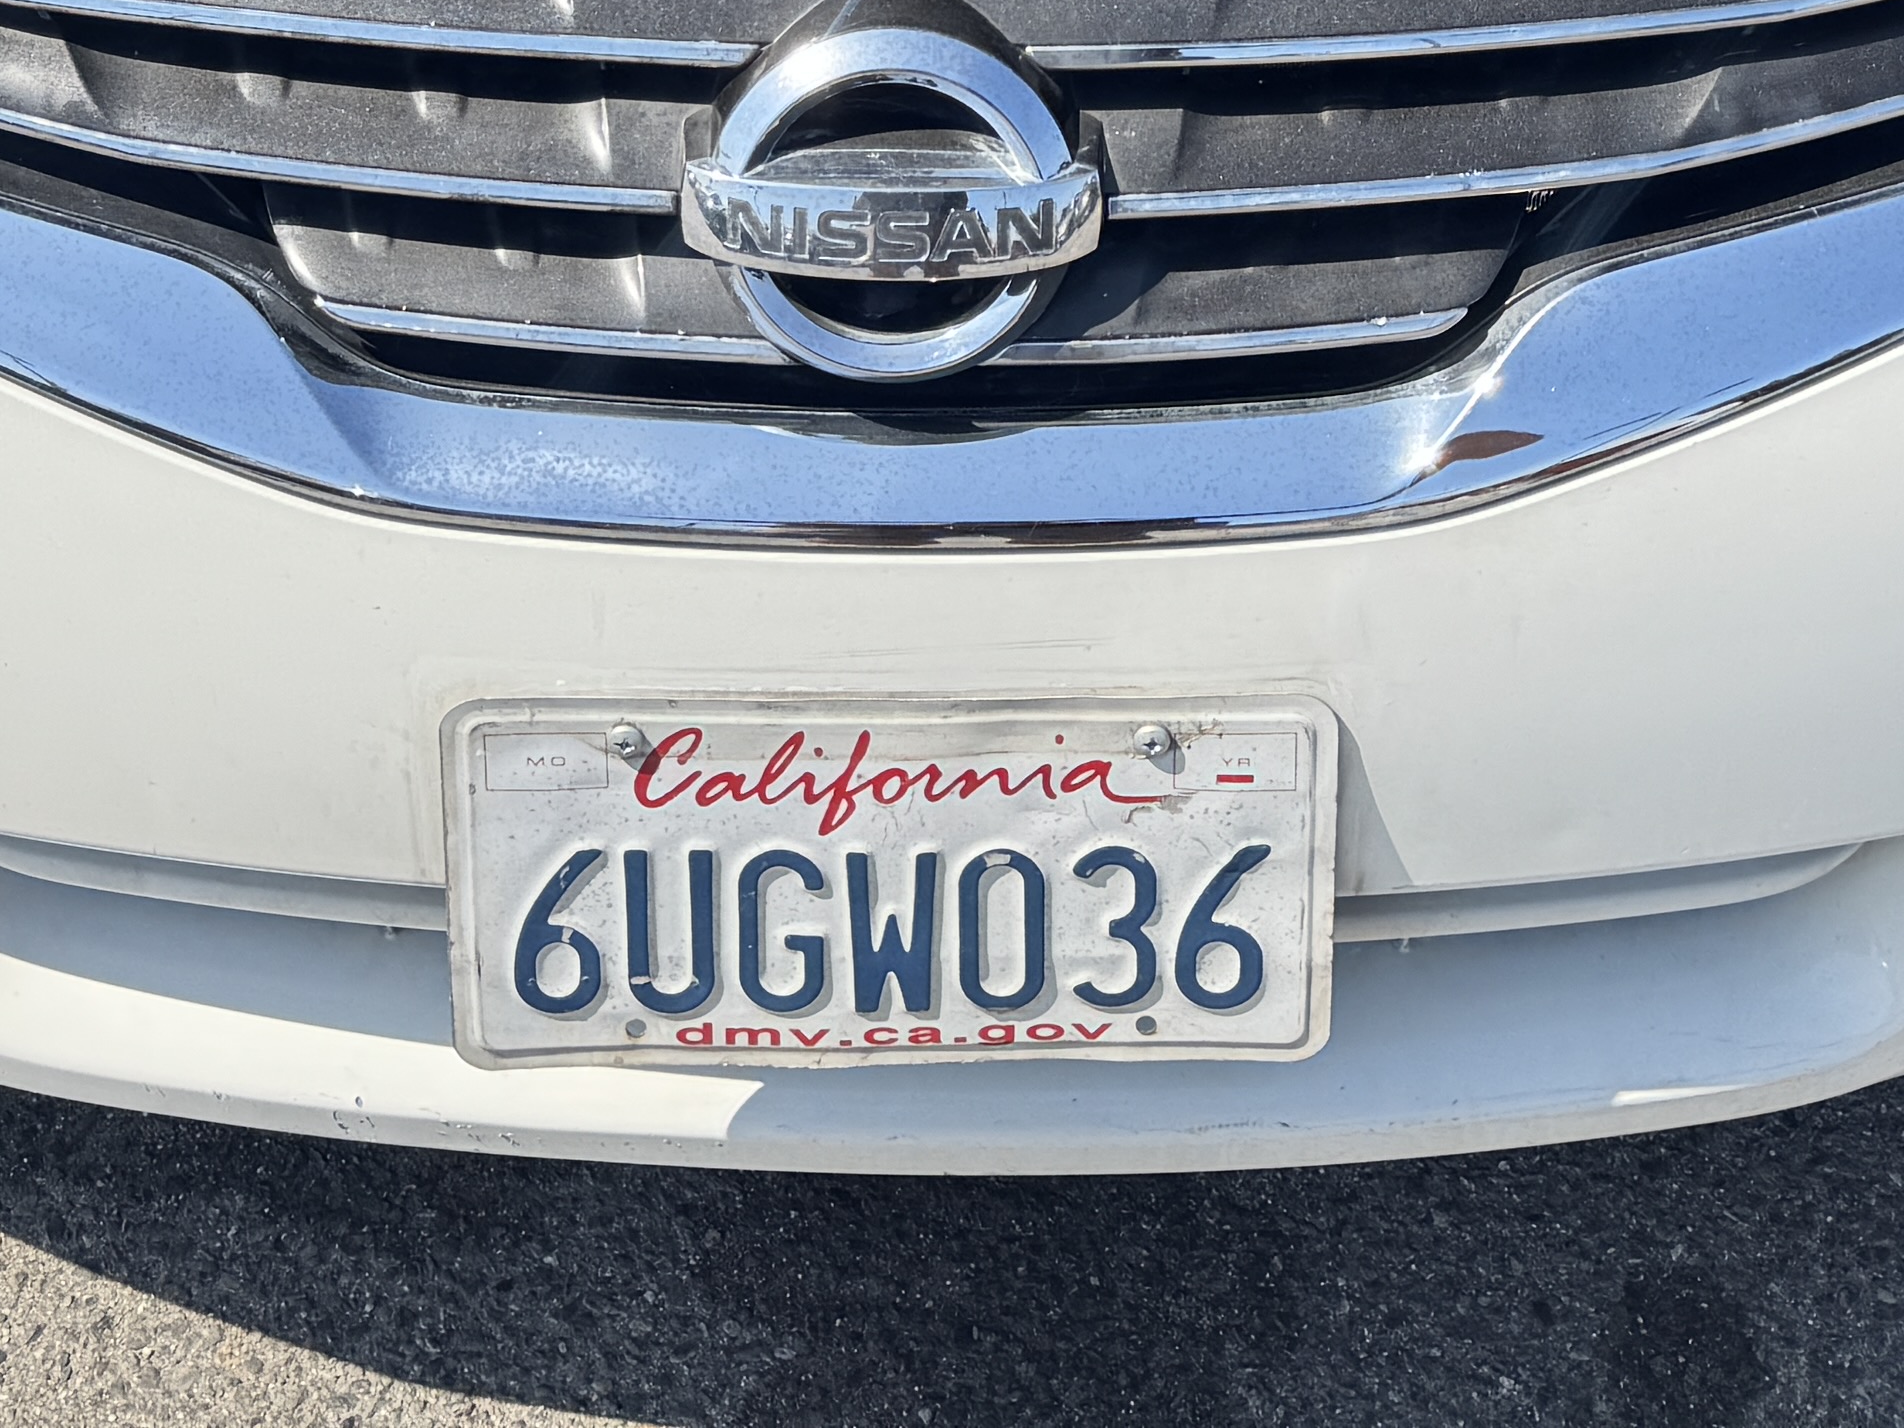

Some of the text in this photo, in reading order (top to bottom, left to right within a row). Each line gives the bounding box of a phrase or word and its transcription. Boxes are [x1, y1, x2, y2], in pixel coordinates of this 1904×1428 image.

[726, 196, 1059, 265] NISSAN
[526, 755, 566, 767] MO
[633, 727, 1164, 836] California
[513, 843, 1272, 1014] 6UGW036
[675, 1020, 1114, 1048] dmv.ca.gov
